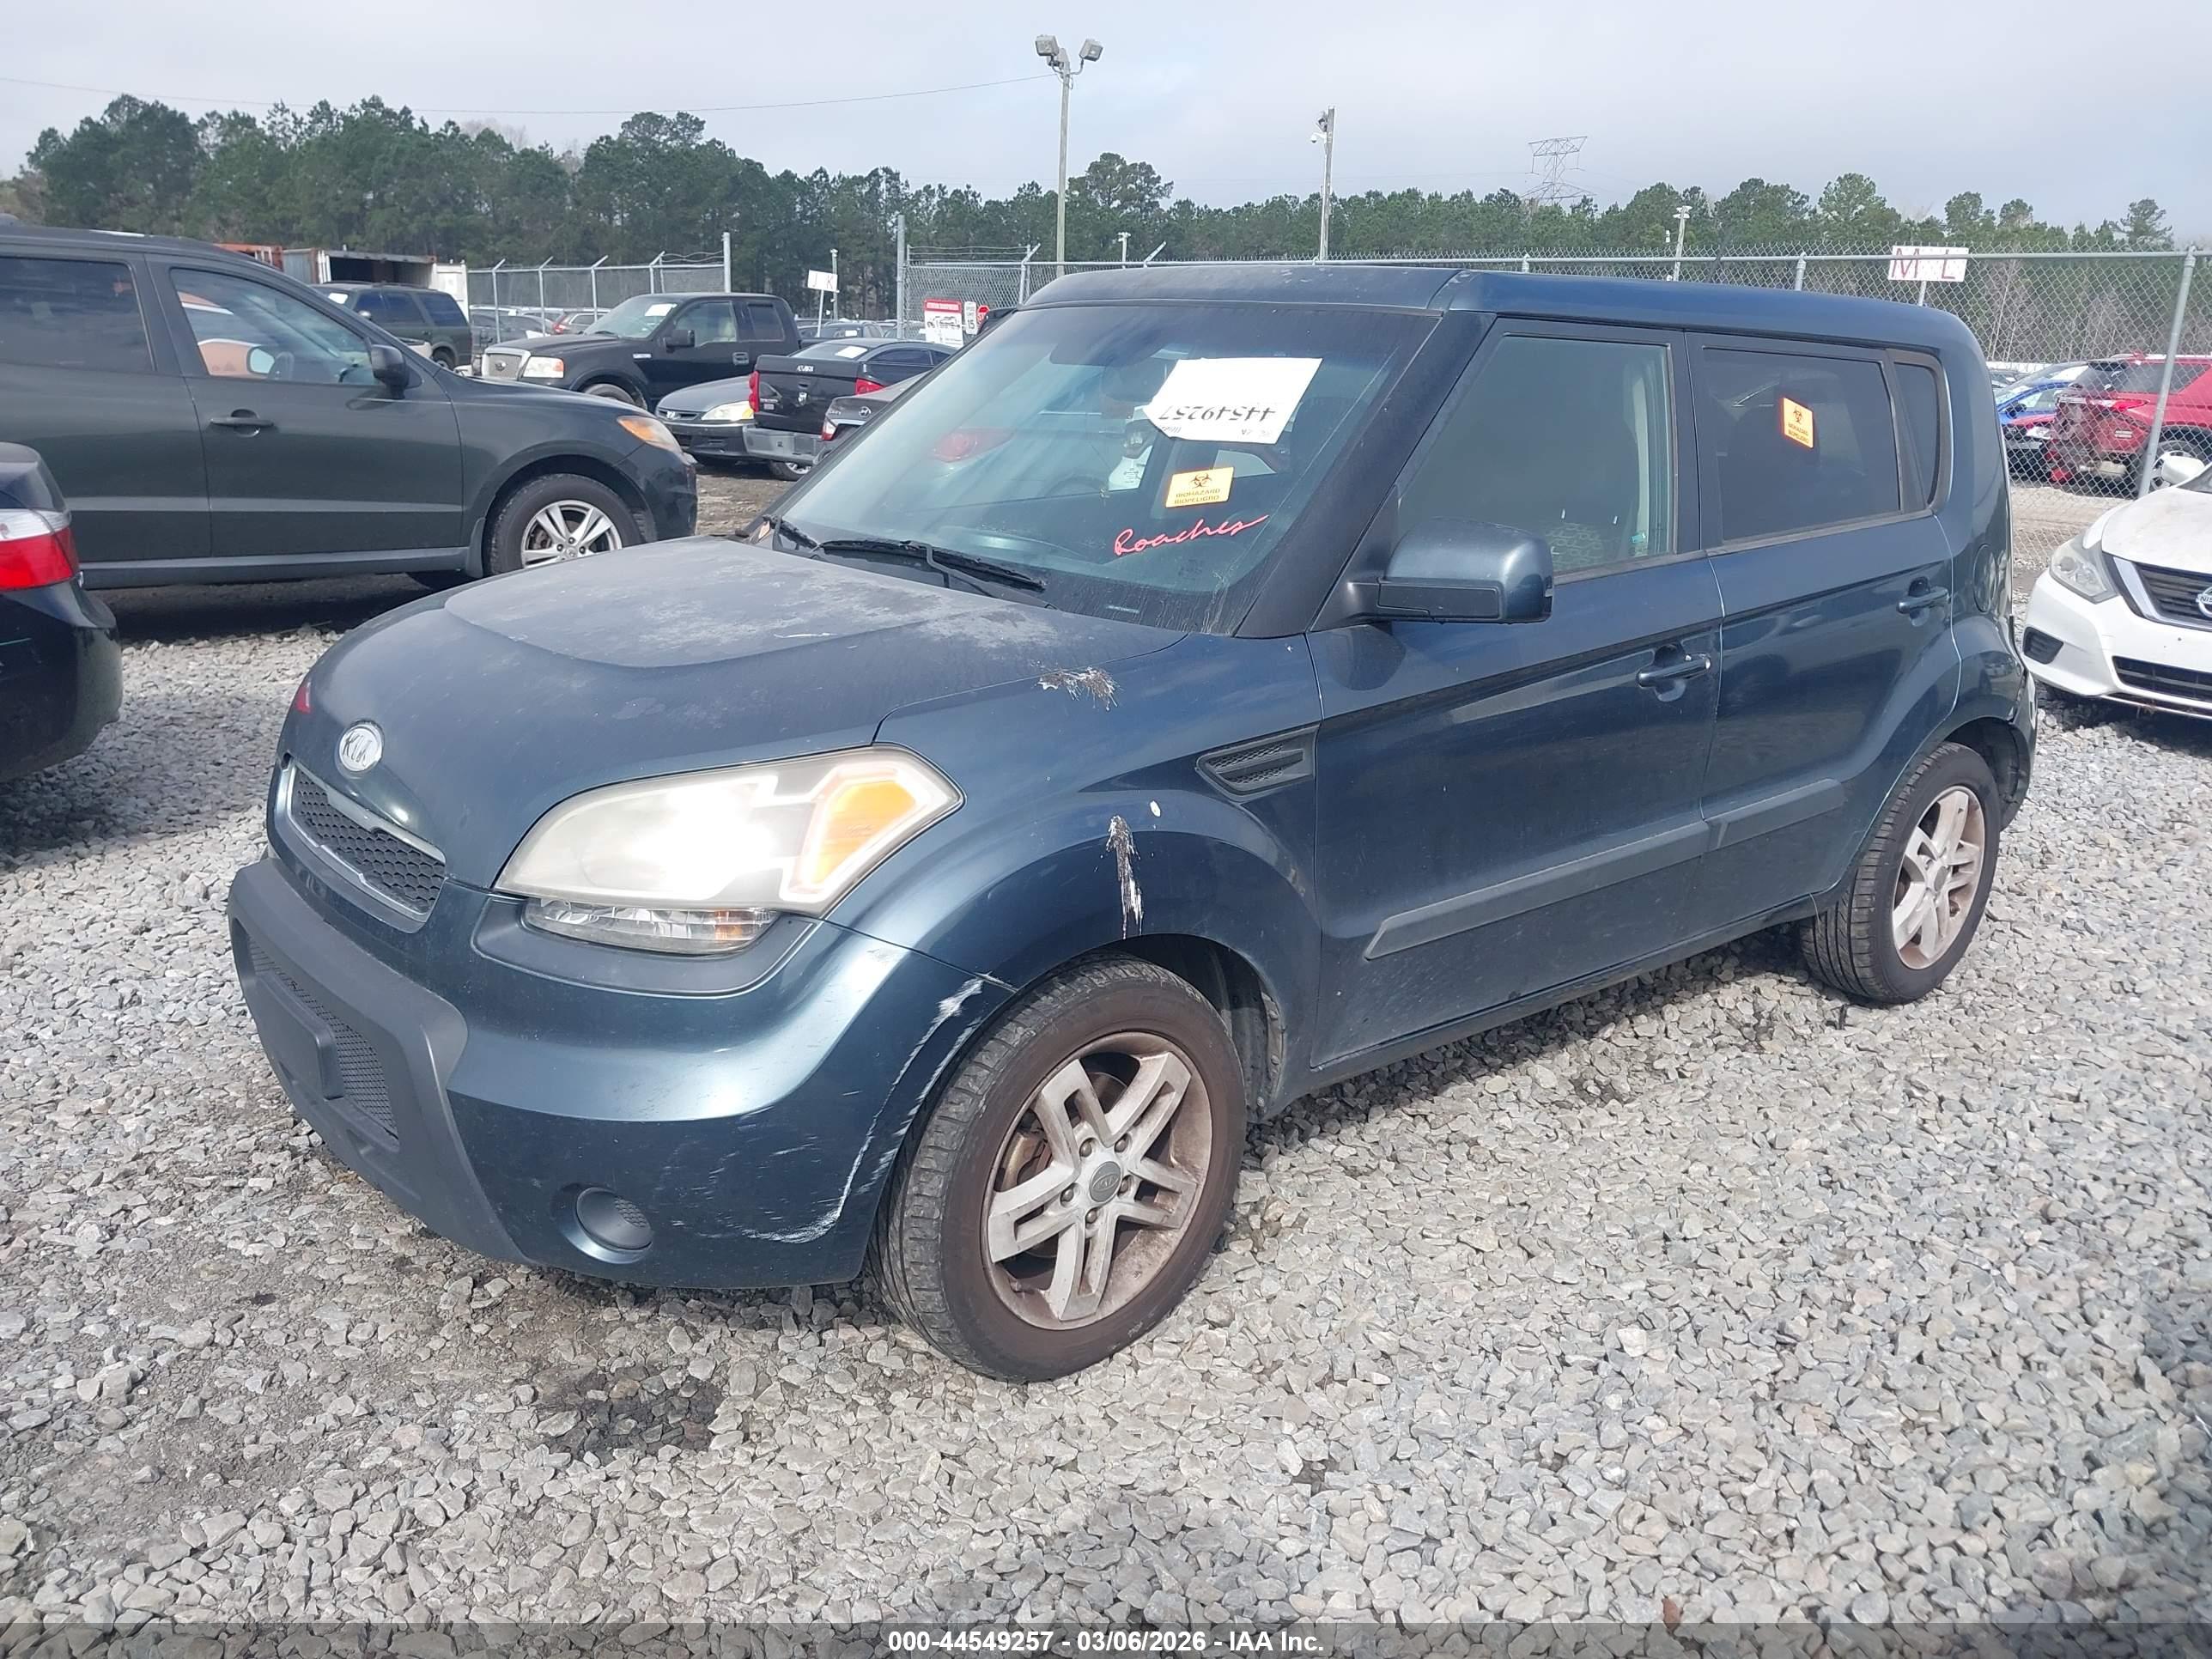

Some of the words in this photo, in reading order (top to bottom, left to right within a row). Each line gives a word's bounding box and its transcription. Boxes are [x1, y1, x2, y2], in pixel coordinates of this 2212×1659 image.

[1891, 248, 1920, 279] M
[1942, 249, 1956, 280] L
[826, 275, 833, 289] K
[967, 319, 975, 330] 15
[1158, 405, 1277, 422] 44549257
[1176, 488, 1221, 498] BIOHAZARD
[1174, 495, 1220, 505] BIOPELIGRO
